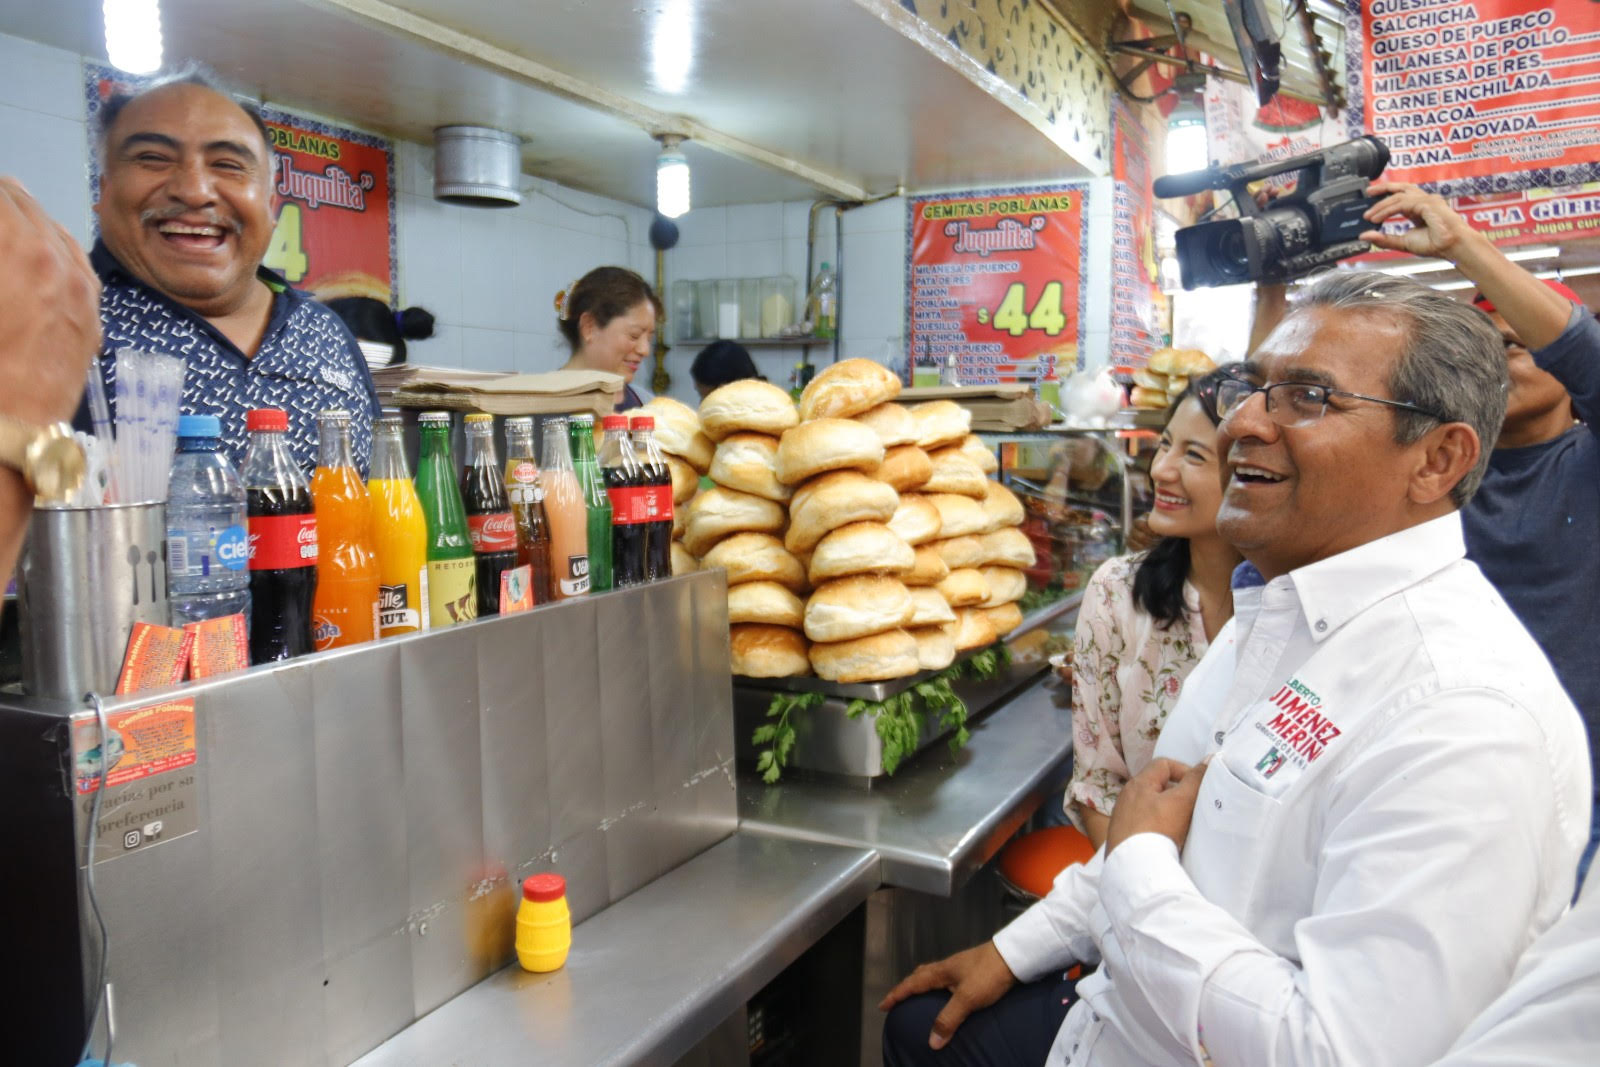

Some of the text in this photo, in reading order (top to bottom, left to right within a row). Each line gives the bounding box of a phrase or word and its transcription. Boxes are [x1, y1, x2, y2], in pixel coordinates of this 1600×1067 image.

[1372, 0, 1459, 15] QUESI
[1373, 6, 1476, 35] SALCHICHA
[1374, 10, 1552, 54] QUESO DE PUERCO
[1375, 29, 1567, 74] MILANESA DE POLLO
[1375, 54, 1540, 93] MILANESA DE RES
[1375, 73, 1551, 111] CARNE ENCHILADA
[1376, 106, 1475, 130] BARBACOA
[1450, 116, 1537, 141] ADOVADA
[267, 128, 339, 158] OBLANAS
[1390, 149, 1452, 167] UBANA
[989, 197, 1070, 214] POBLANAS
[1533, 222, 1574, 234] Jugos
[1577, 218, 1600, 229] cur
[915, 262, 1018, 274] MILANESA DE PUERCO
[915, 277, 936, 285] PATA
[954, 275, 971, 283] RES
[916, 289, 947, 297] JAMON
[915, 300, 958, 308] POBLANA
[915, 311, 941, 319] MIXTA
[915, 322, 959, 330] QUESILLO
[948, 345, 959, 353] DE
[962, 344, 1001, 352] PUERCO
[963, 356, 973, 364] DE
[976, 356, 1008, 364] POLLO
[963, 367, 973, 375] DE
[976, 367, 995, 375] RES
[219, 535, 248, 560] ciel
[1269, 685, 1342, 746] JIMÉNEZ
[1266, 712, 1324, 763] MERIN
[82, 776, 194, 815] Gacias por su
[97, 799, 185, 838] preferencia
